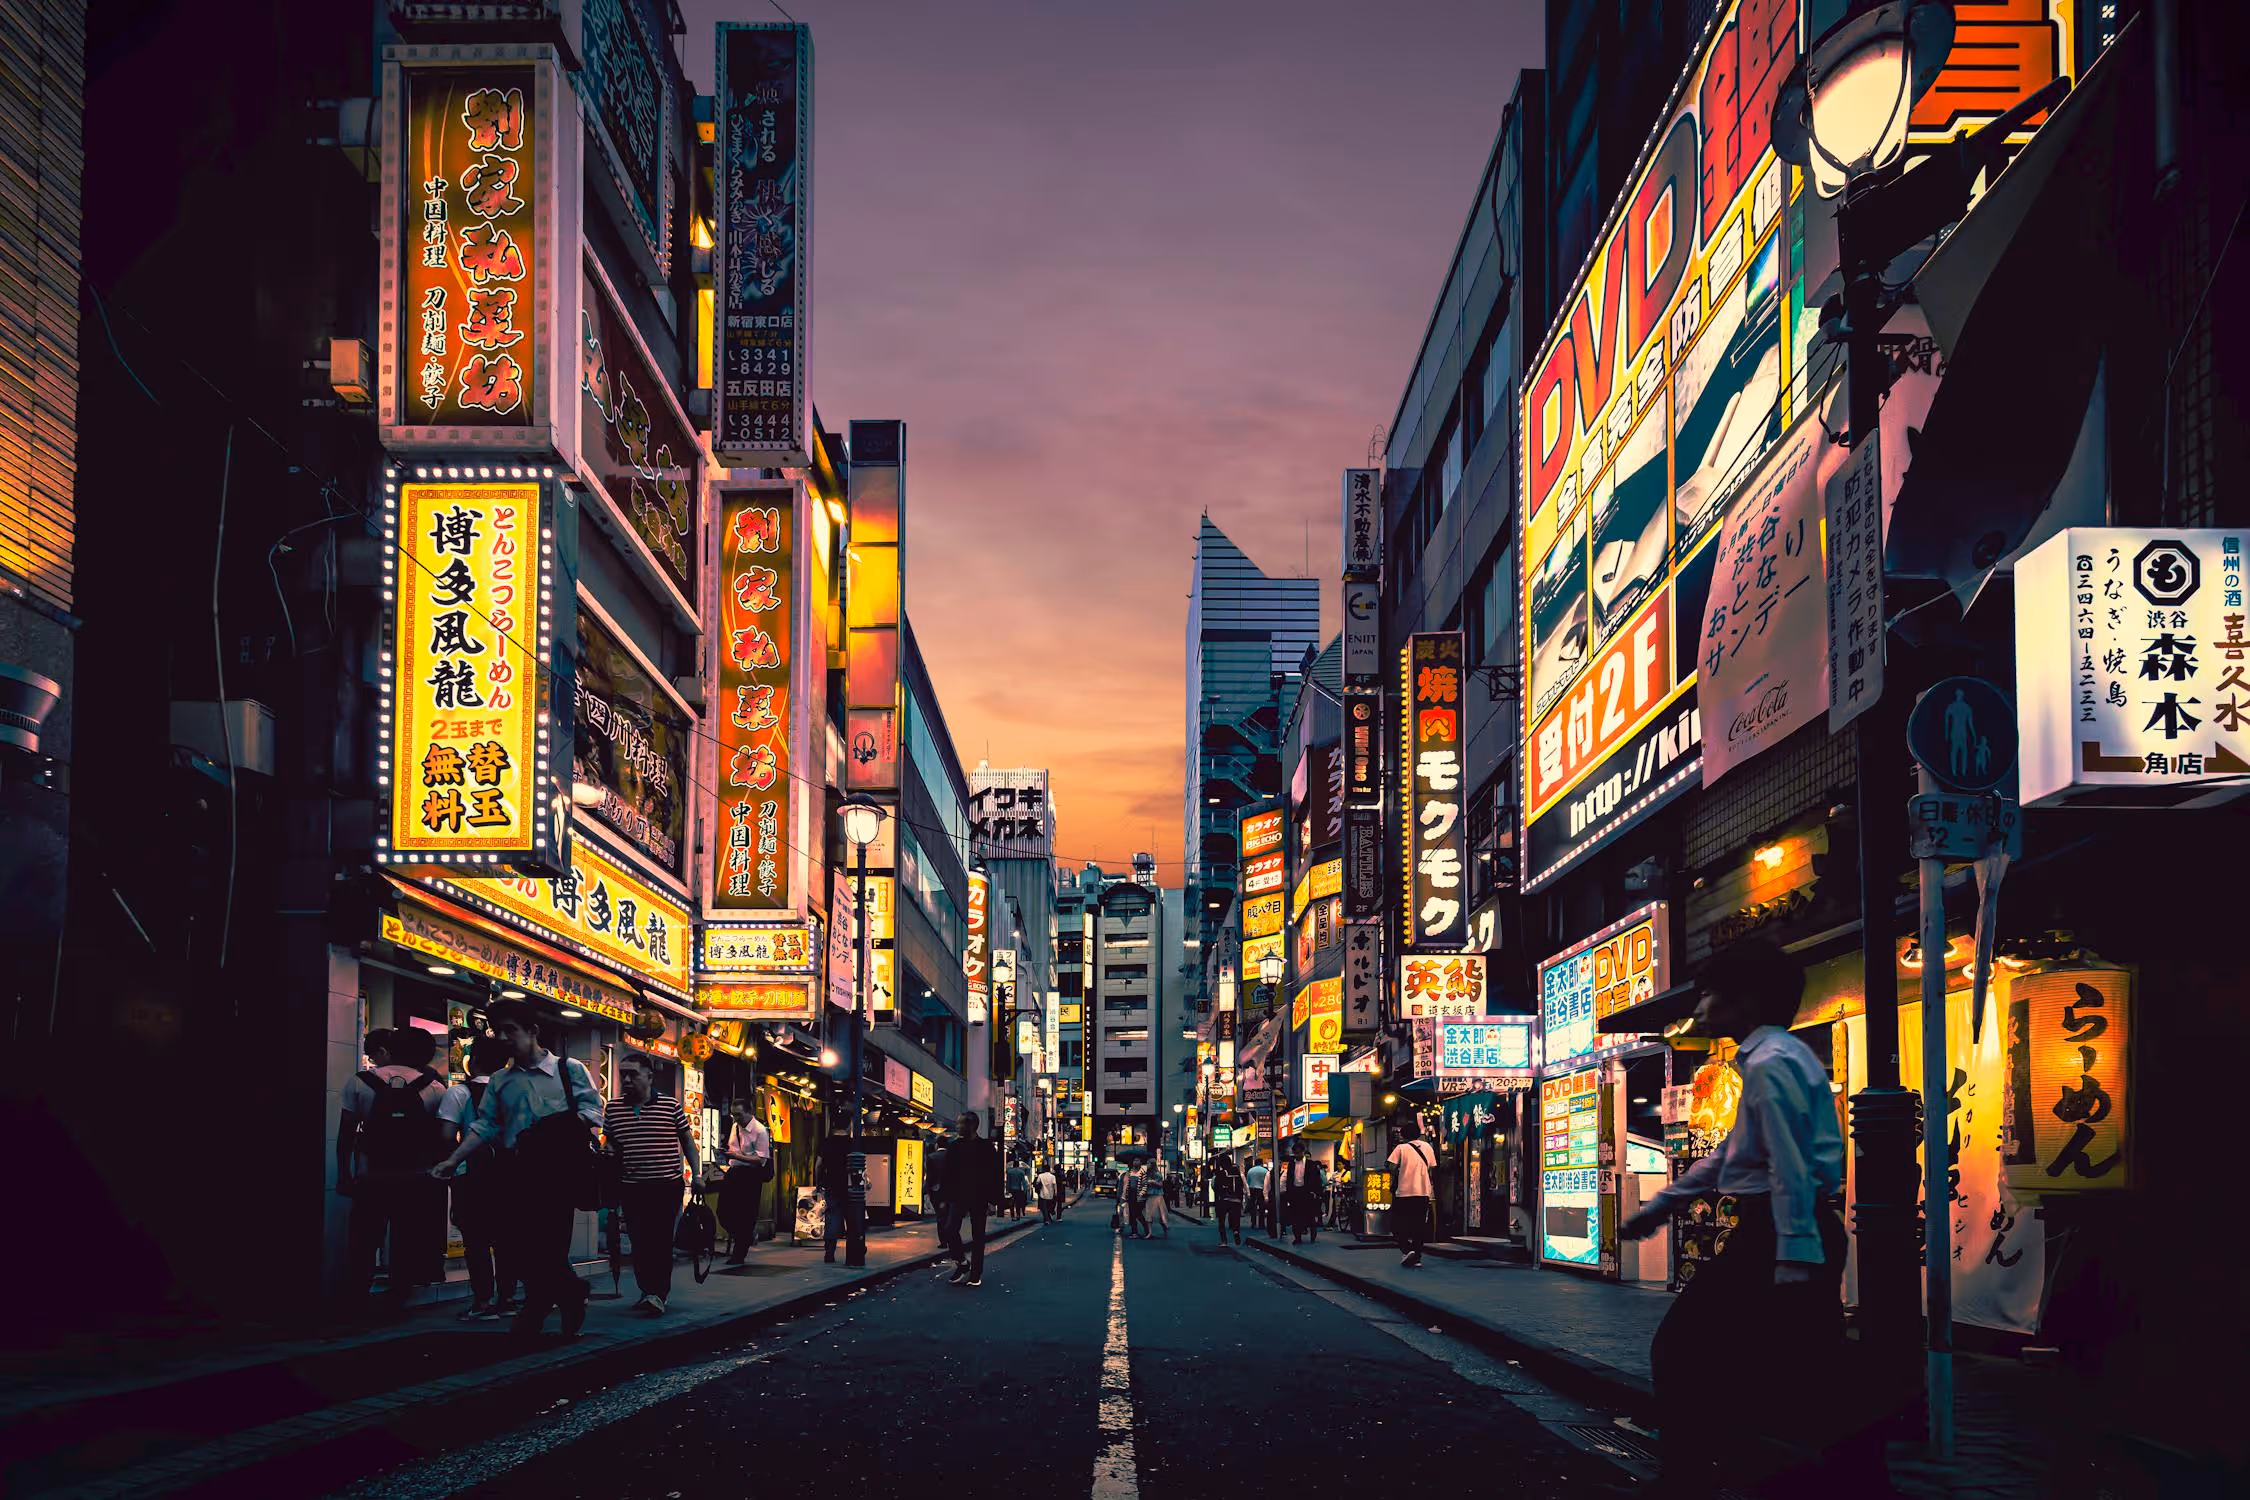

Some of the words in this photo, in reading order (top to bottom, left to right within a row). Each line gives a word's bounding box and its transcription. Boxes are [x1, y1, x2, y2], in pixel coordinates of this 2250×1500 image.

[423, 176, 448, 268] 中国料理
[727, 315, 793, 328] 新宿東口店
[740, 348, 789, 361] 3341
[726, 380, 792, 397] 五反田店
[740, 414, 790, 426] 3444
[2222, 537, 2241, 607] 信州の酒
[1845, 468, 1864, 703] 防犯カメラ作動中
[427, 506, 485, 711] 博多風龍
[488, 506, 517, 710] とんこつらーめん
[2147, 610, 2188, 629] 渋谷
[1706, 575, 1810, 678] サンデー
[1416, 641, 1459, 660] 炭火
[1355, 675, 1370, 683] 4F
[2213, 613, 2250, 732] 喜久水
[2139, 633, 2202, 739] 森本
[1538, 611, 1657, 797] 受付2F
[430, 717, 502, 742] 2玉まで
[575, 668, 668, 797] 四川料理
[2145, 753, 2201, 775] 角店
[969, 786, 1043, 811] イワキ
[1416, 665, 1461, 936] 焼肉モクモク
[969, 817, 1044, 841] メガネ
[1246, 816, 1282, 834] カラオケ
[729, 802, 751, 896] 中国料理
[1246, 838, 1261, 850] BIG
[1261, 832, 1282, 845] ECHO
[1245, 858, 1281, 875] カラオケ
[548, 864, 671, 968] 博多風龍
[1247, 900, 1281, 918] 腹八分目
[1355, 904, 1368, 913] 2F
[967, 884, 986, 979] カラオケ
[709, 944, 770, 960] 博多風龍
[831, 944, 853, 963] サンデ
[1594, 927, 1653, 992] DVD
[1404, 959, 1483, 1002] 英鮨
[1546, 960, 1579, 1000] 金太郎
[1428, 1005, 1476, 1016] 道玄坂店
[1546, 986, 1592, 1028] 渋谷書店
[1357, 1017, 1368, 1025] B1
[1446, 1027, 1484, 1045] 金太郎
[1446, 1048, 1498, 1065] 渋谷書店
[2046, 982, 2121, 1179] らーめん
[1544, 1169, 1597, 1191] 金太郎渋谷書店
